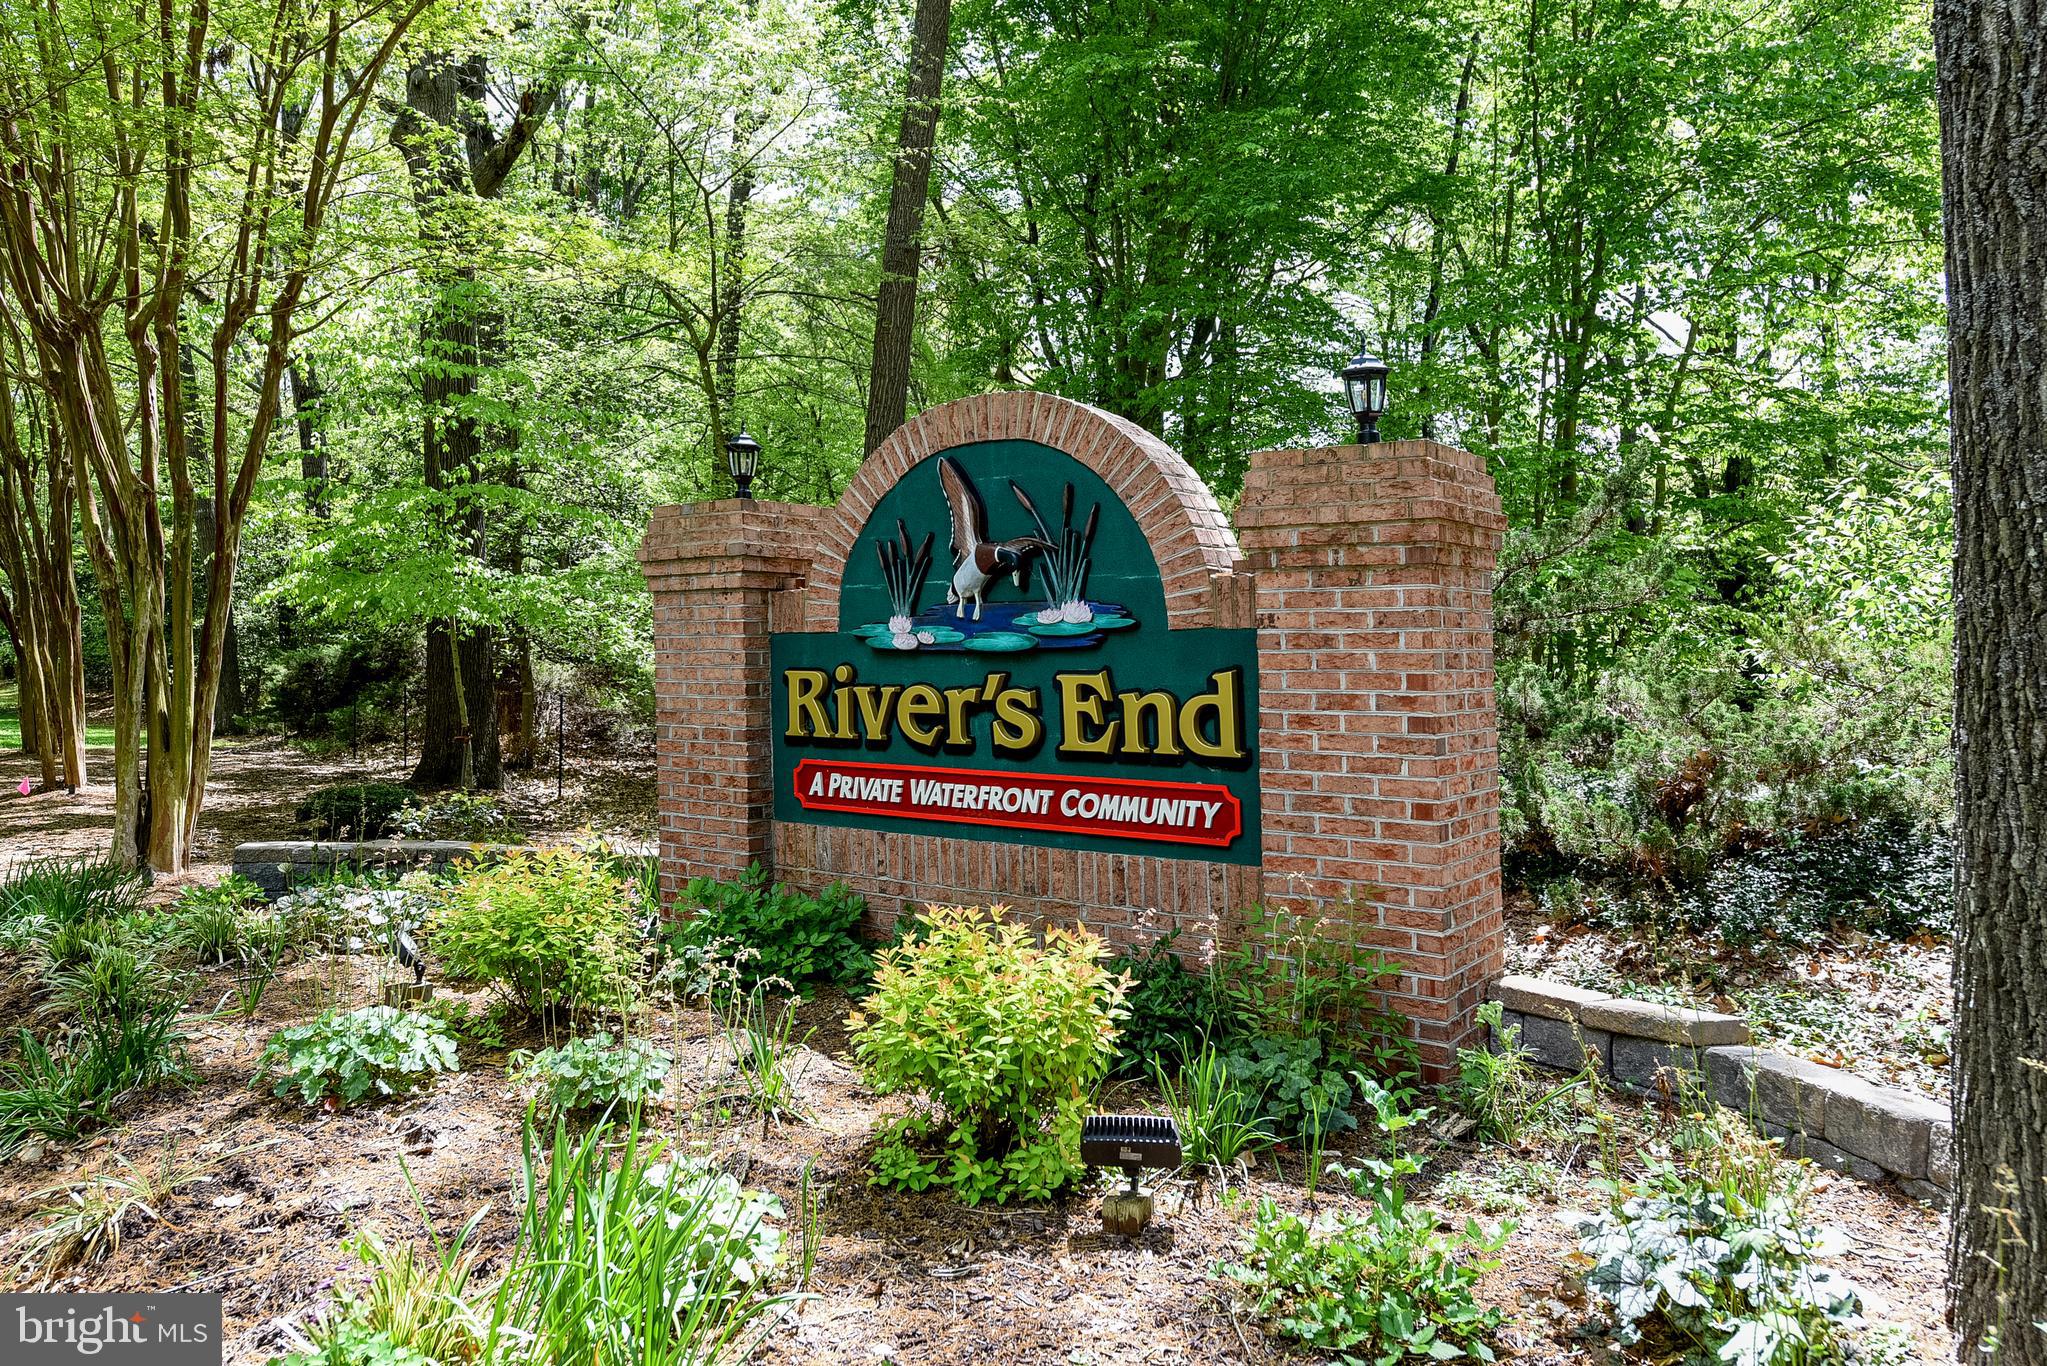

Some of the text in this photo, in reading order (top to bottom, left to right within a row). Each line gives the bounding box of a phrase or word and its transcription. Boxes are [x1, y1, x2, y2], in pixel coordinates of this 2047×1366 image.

[784, 665, 1247, 759] River's End
[808, 772, 1223, 829] A PRIVATE WATERFRONT COMMUNITY
